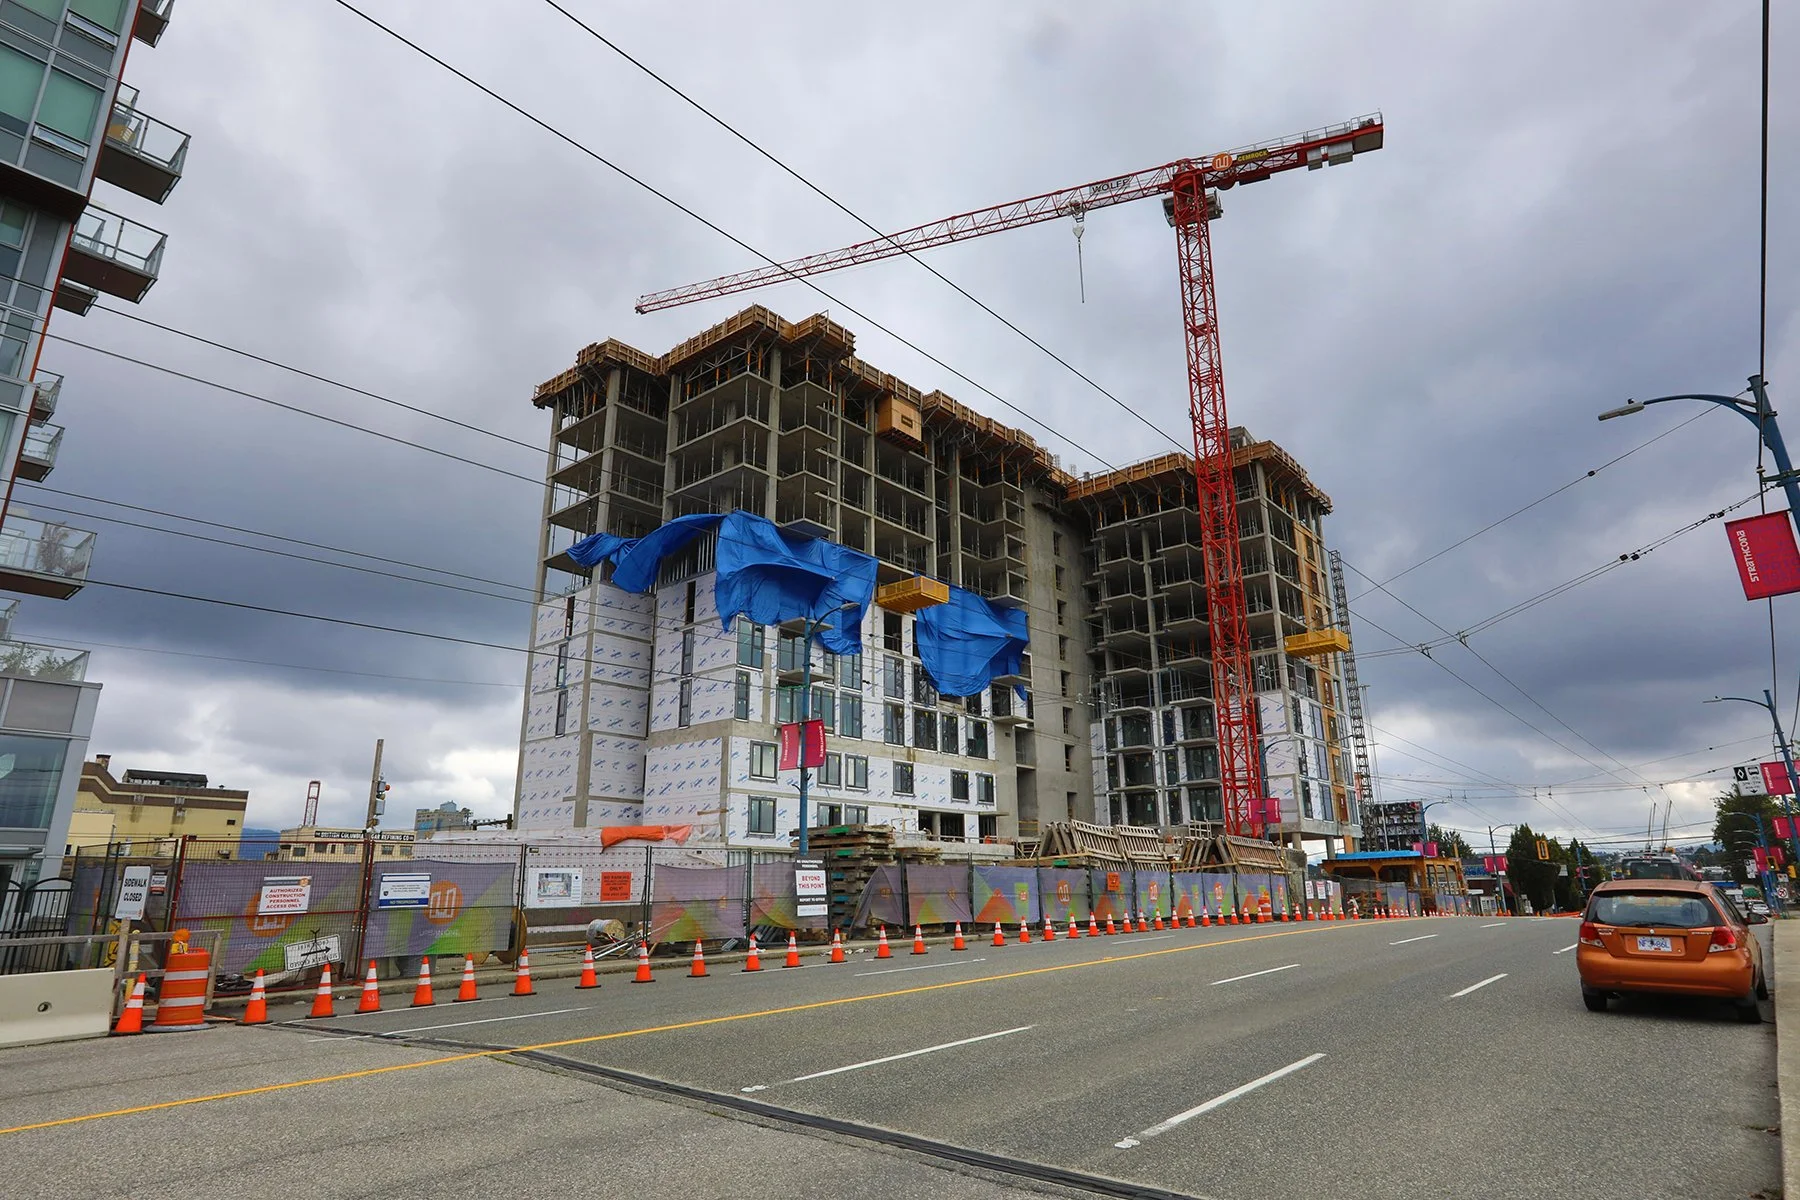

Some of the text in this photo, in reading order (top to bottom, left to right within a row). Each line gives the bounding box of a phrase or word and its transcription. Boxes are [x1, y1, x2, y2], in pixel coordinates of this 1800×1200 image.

[1237, 149, 1268, 162] CEMROCK
[124, 878, 147, 887] SIDEWALK
[124, 893, 141, 901] CLOSED
